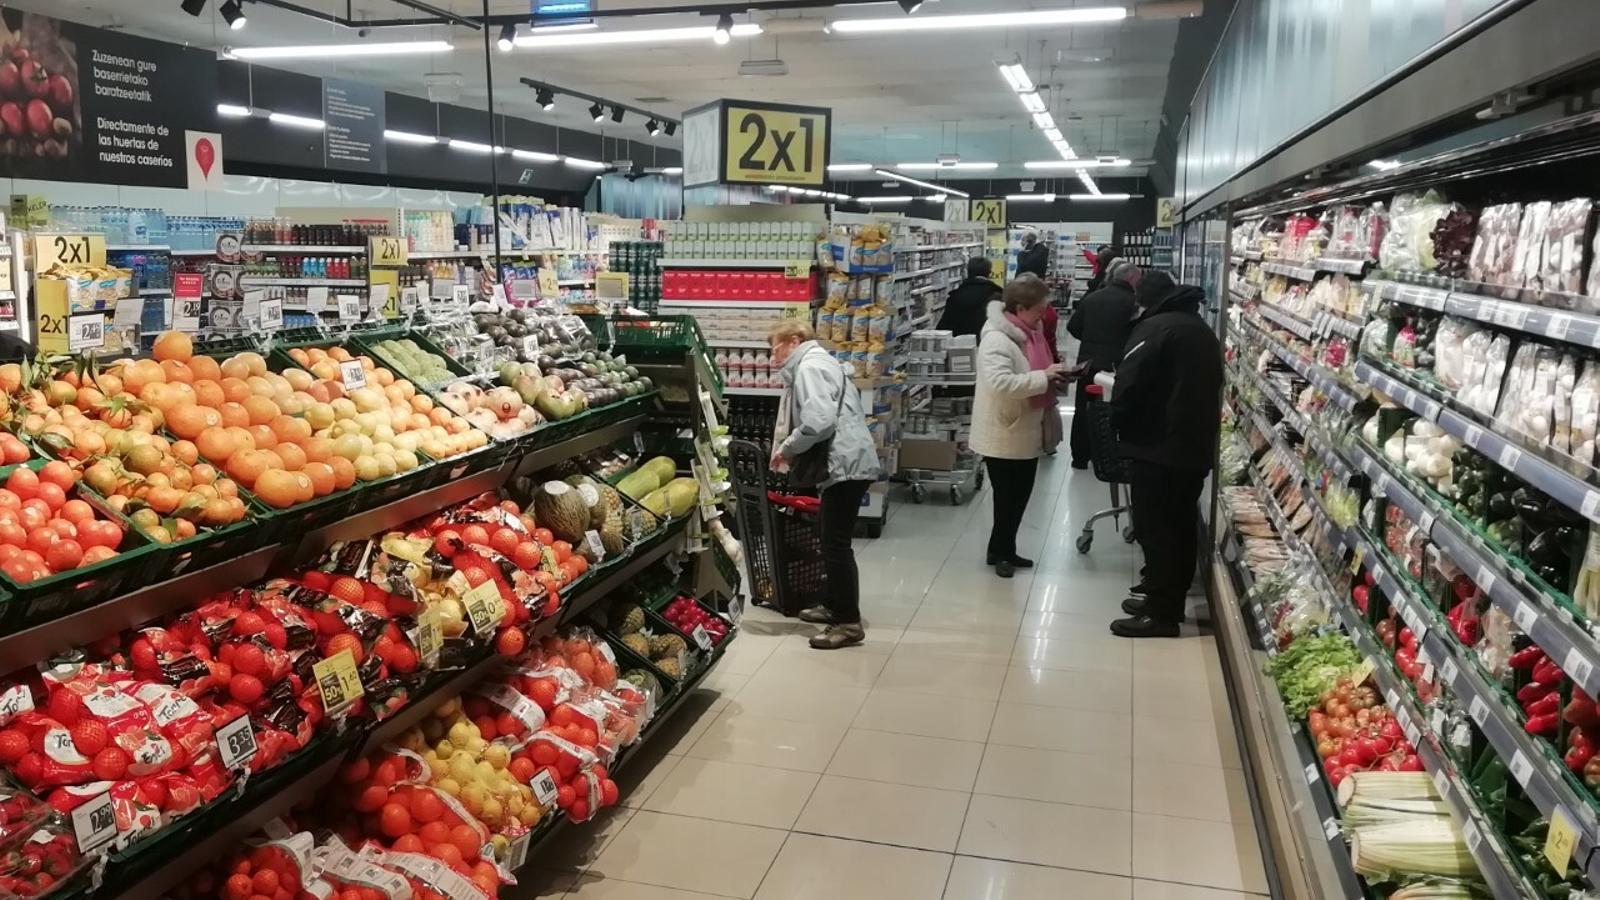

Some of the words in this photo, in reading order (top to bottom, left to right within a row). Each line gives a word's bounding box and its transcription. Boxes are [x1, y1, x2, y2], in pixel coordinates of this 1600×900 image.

[92, 49, 135, 68] Zuzenean
[137, 61, 157, 72] gure
[93, 66, 148, 86] baserrietako
[95, 83, 152, 102] baratzeetatik
[97, 117, 155, 135] Directamente
[157, 125, 169, 136] de
[98, 133, 111, 145] las
[113, 135, 145, 149] huertas
[147, 139, 159, 150] de
[739, 112, 814, 172] 2x1
[99, 152, 135, 164] nuestros
[137, 155, 173, 167] caseríos
[976, 201, 1002, 224] 2x1
[55, 236, 91, 264] 2x1
[382, 239, 400, 259] 2x1
[40, 314, 68, 334] 2x1
